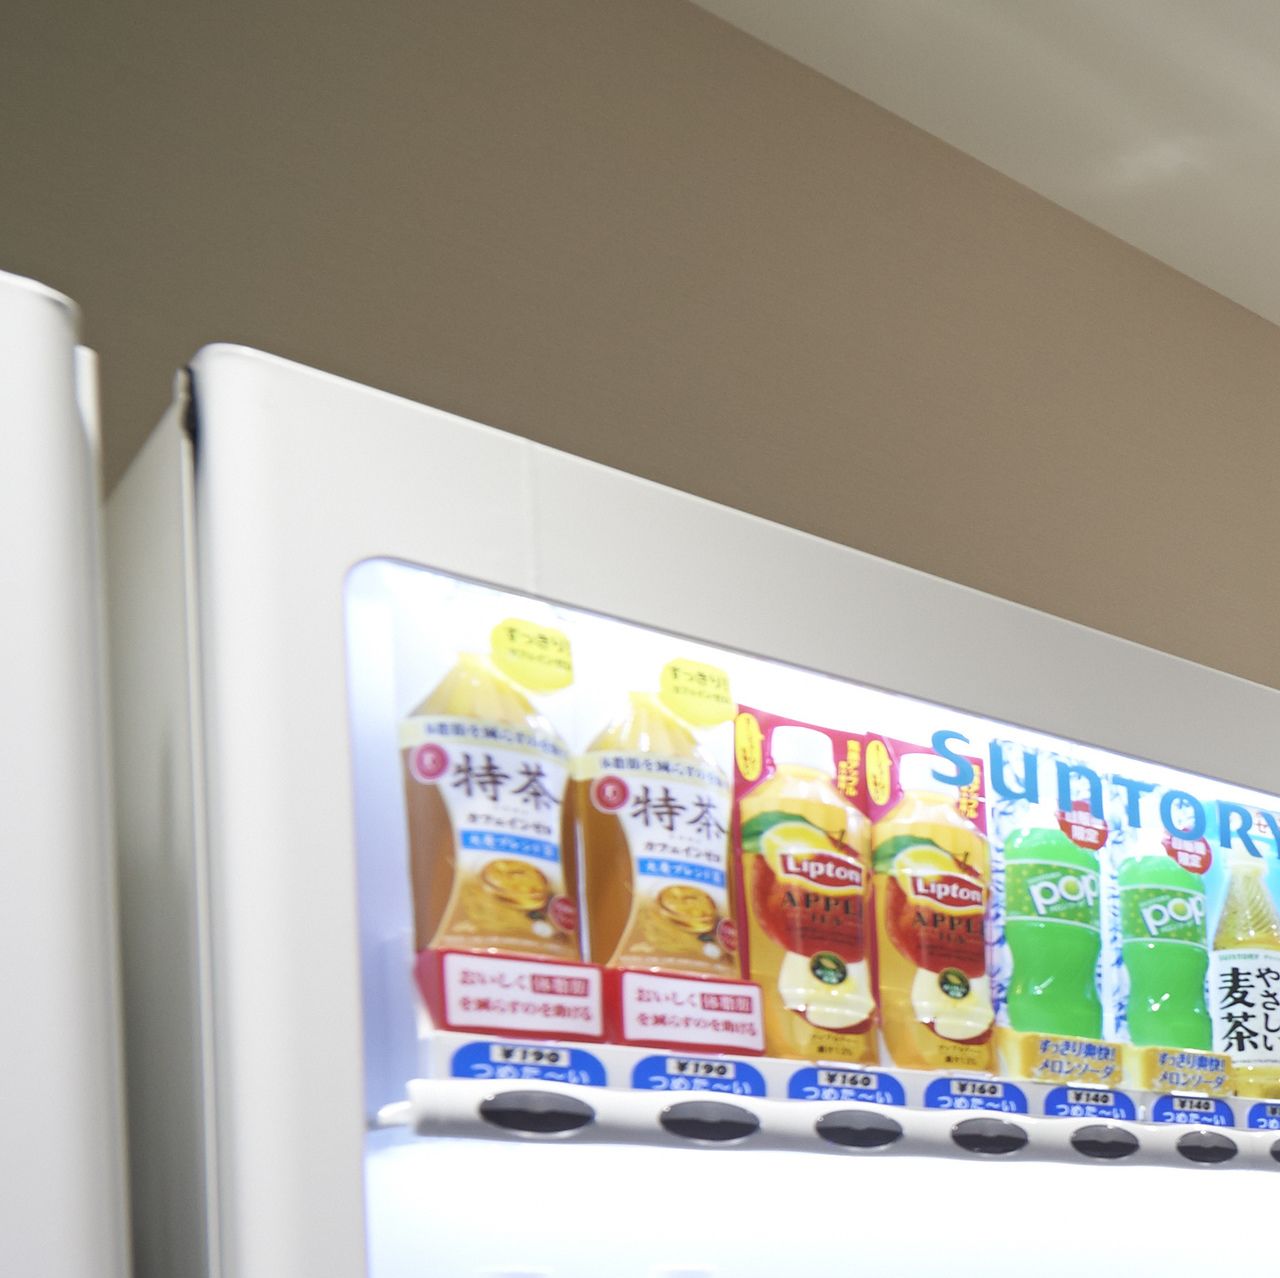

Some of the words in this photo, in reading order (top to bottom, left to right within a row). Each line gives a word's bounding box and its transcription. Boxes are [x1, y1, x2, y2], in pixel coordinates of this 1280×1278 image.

[453, 753, 561, 810] 特茶
[632, 784, 728, 840] 特茶
[787, 854, 862, 883] Lipton
[917, 878, 982, 900] Lipton
[781, 890, 860, 915] APPL
[1219, 967, 1258, 1053] 麦茶
[500, 1048, 559, 1063] ¥190
[676, 1062, 726, 1076] ¥190
[1038, 1060, 1114, 1079] メロンソーダ
[826, 1074, 871, 1087] ¥160
[958, 1081, 997, 1095] ¥160
[1159, 1072, 1225, 1088] メロンソーダ
[1074, 1092, 1109, 1104] ¥140
[1179, 1100, 1210, 1111] ¥140
